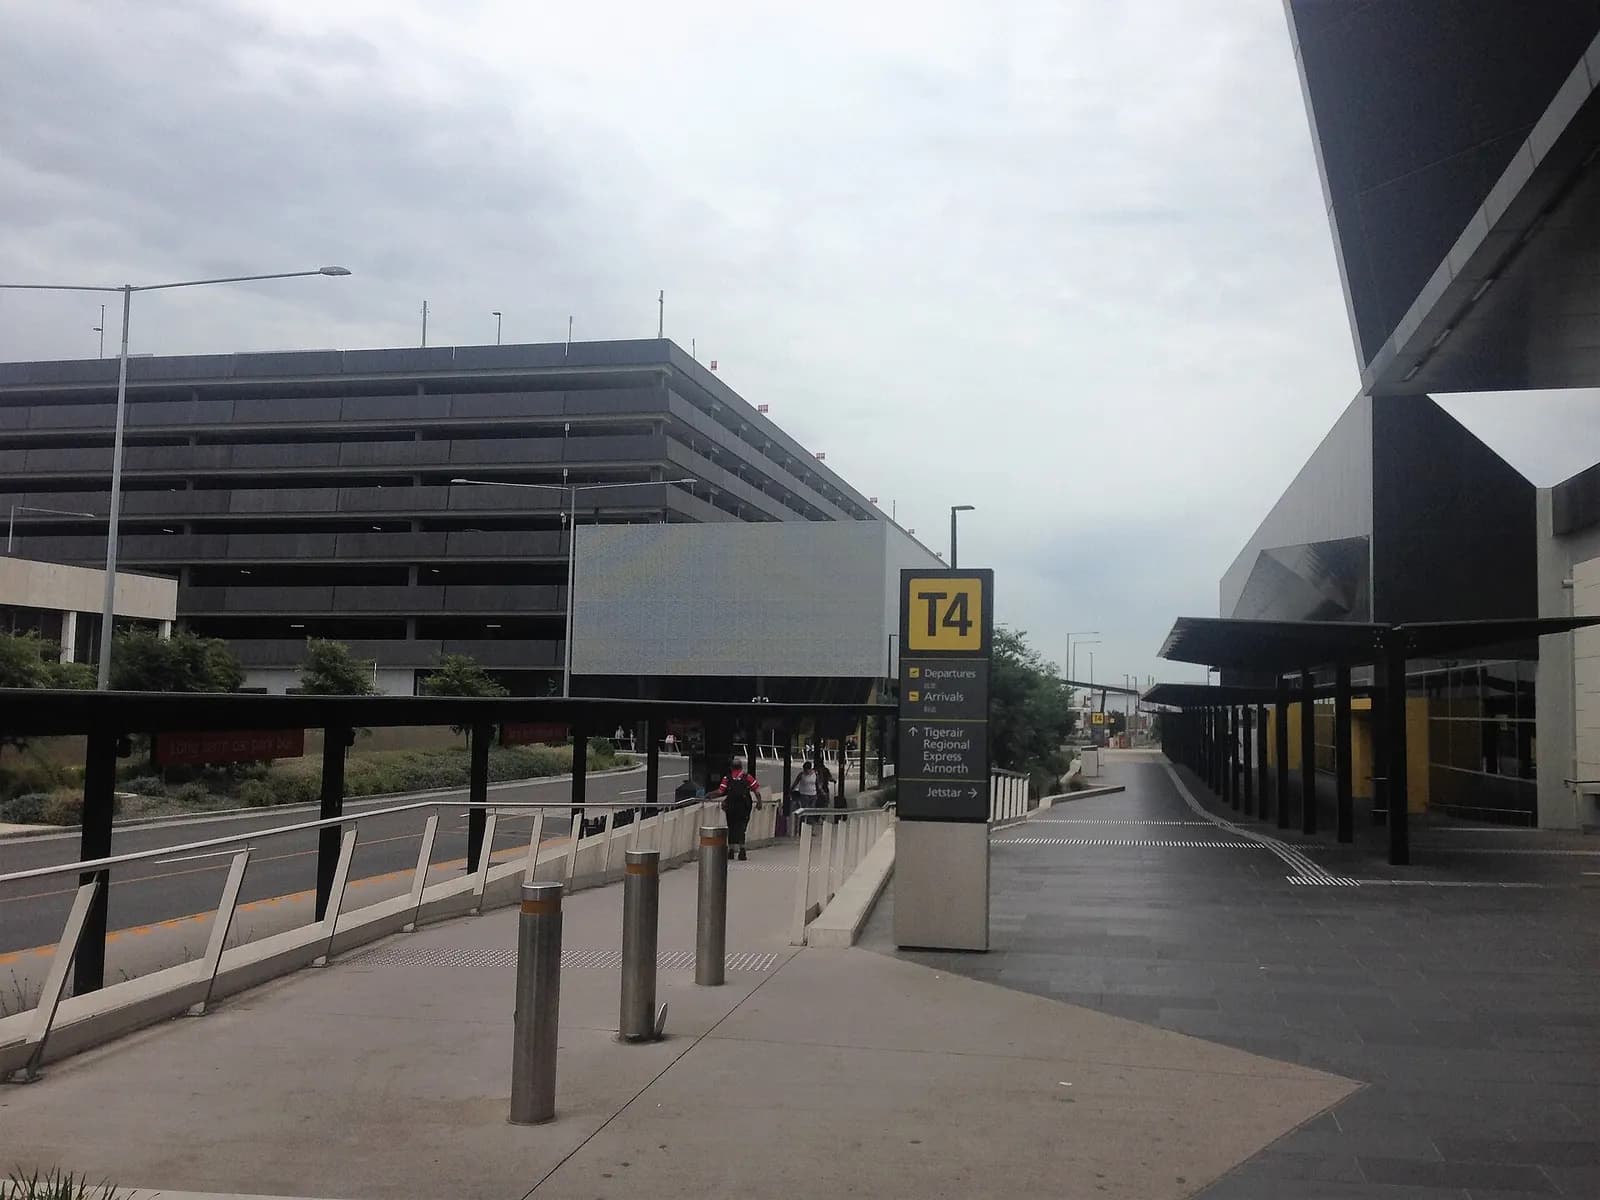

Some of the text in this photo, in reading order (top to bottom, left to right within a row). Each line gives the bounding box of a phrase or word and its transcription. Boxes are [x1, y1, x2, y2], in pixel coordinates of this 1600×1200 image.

[917, 592, 973, 637] T4
[924, 668, 977, 680] Departures
[923, 692, 964, 702] Arrivals
[923, 727, 965, 740] Tigerair
[923, 739, 970, 751] Regional
[923, 751, 962, 763] Express
[922, 763, 969, 773] Airnorth
[927, 787, 962, 797] Jetstar
